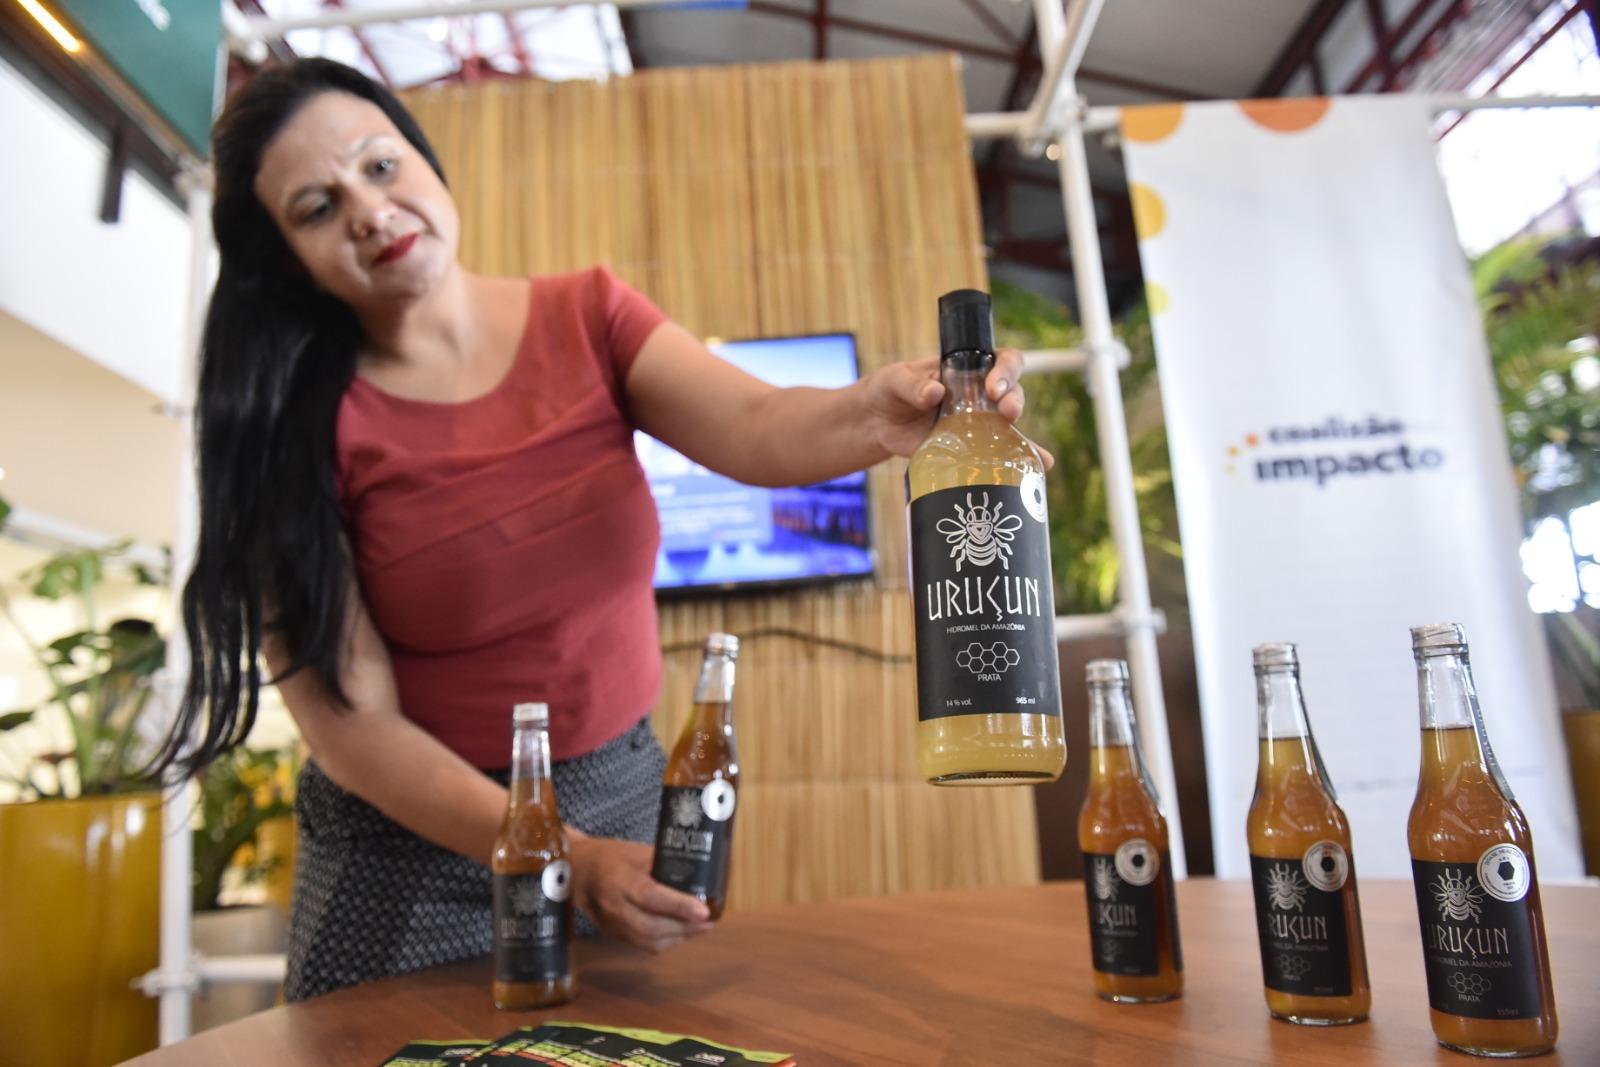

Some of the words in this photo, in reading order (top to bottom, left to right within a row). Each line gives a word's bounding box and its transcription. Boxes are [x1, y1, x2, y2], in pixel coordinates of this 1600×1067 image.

[1255, 444, 1444, 485] impacto
[927, 575, 1041, 621] URUÇUN
[946, 624, 979, 634] HIDROMEL
[980, 623, 991, 632] DA
[991, 622, 1026, 631] AMAZÔNIA
[977, 673, 1002, 681] PRATA
[1015, 696, 1027, 705] 965
[1027, 697, 1036, 705] ml
[1265, 913, 1328, 944] RUÇUN
[1458, 993, 1481, 1002] PRATA
